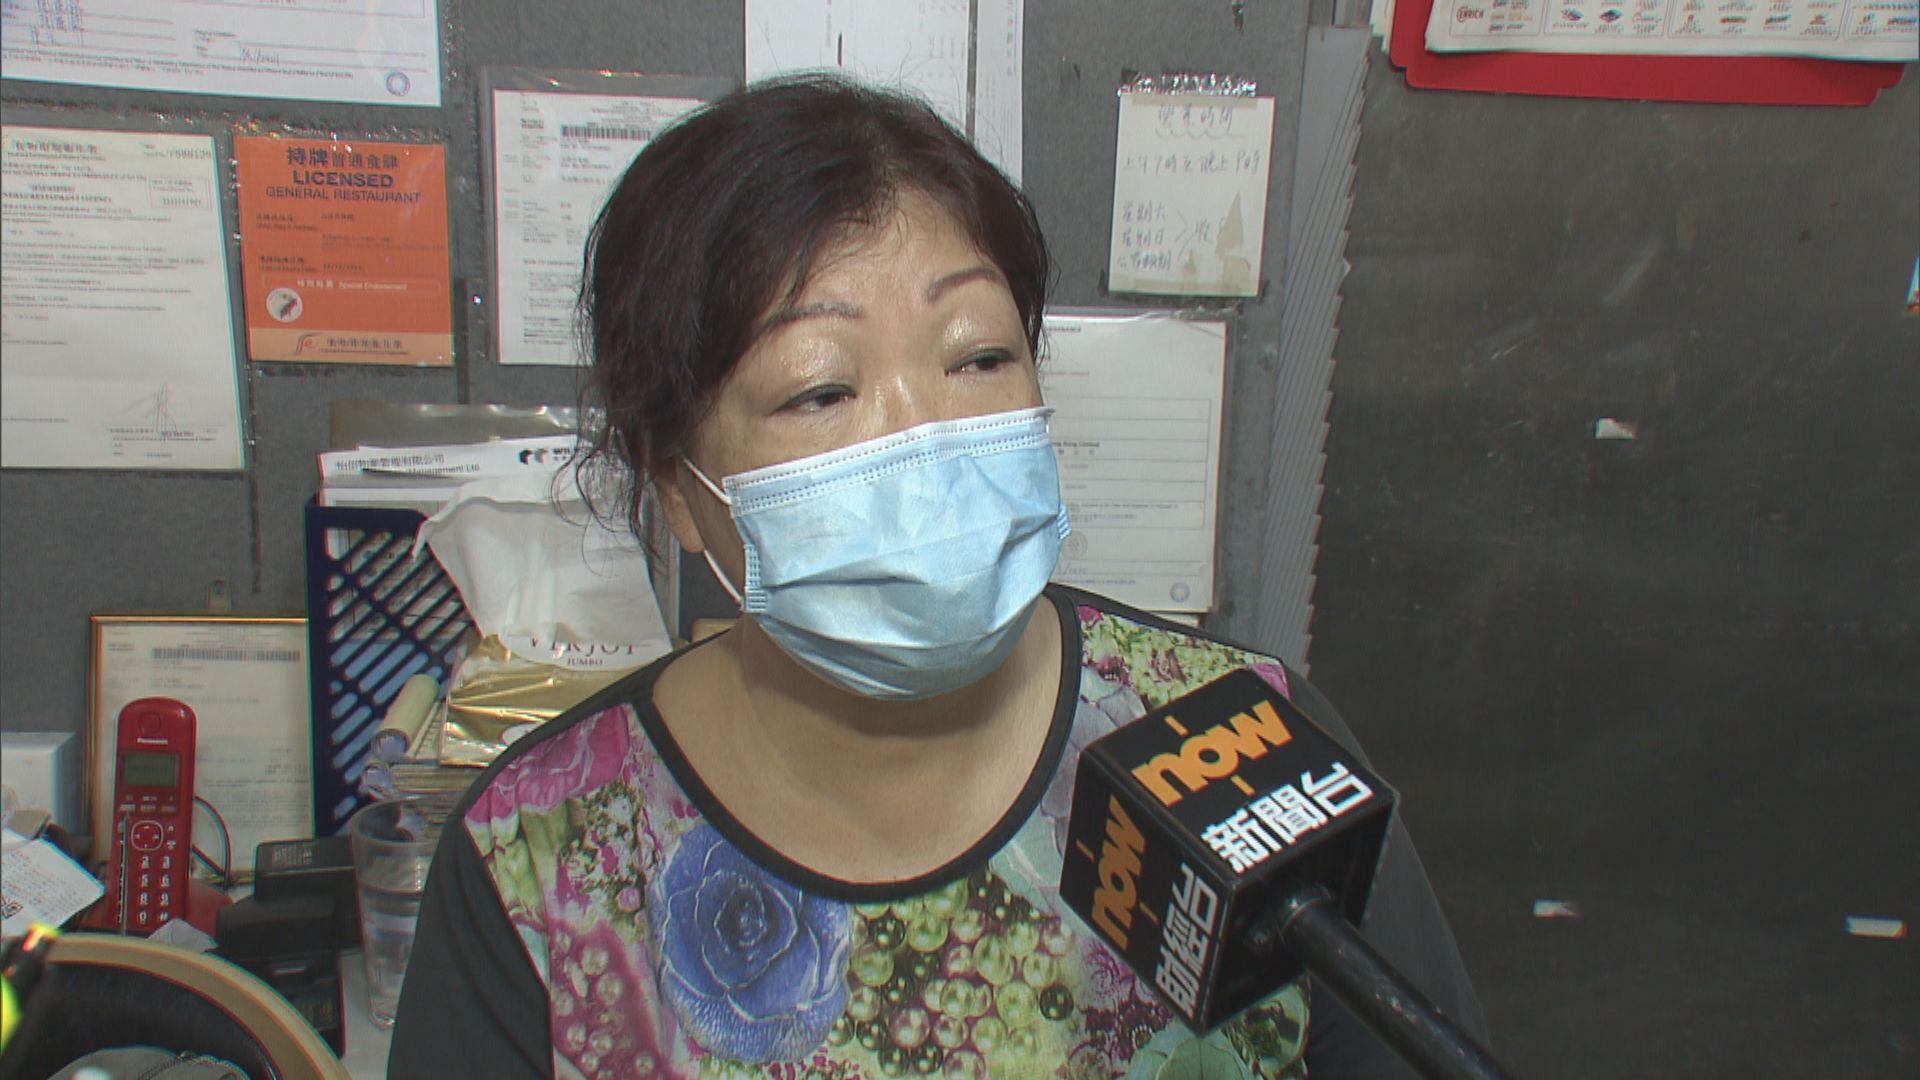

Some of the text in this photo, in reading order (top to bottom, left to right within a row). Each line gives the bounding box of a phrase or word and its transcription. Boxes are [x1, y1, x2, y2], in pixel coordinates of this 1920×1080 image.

[266, 185, 422, 204] GENERAL RESTAURANT
[291, 170, 395, 188] LICENSED
[1131, 699, 1294, 808] now
[1200, 761, 1374, 874] 新聞台
[1091, 795, 1147, 951] now
